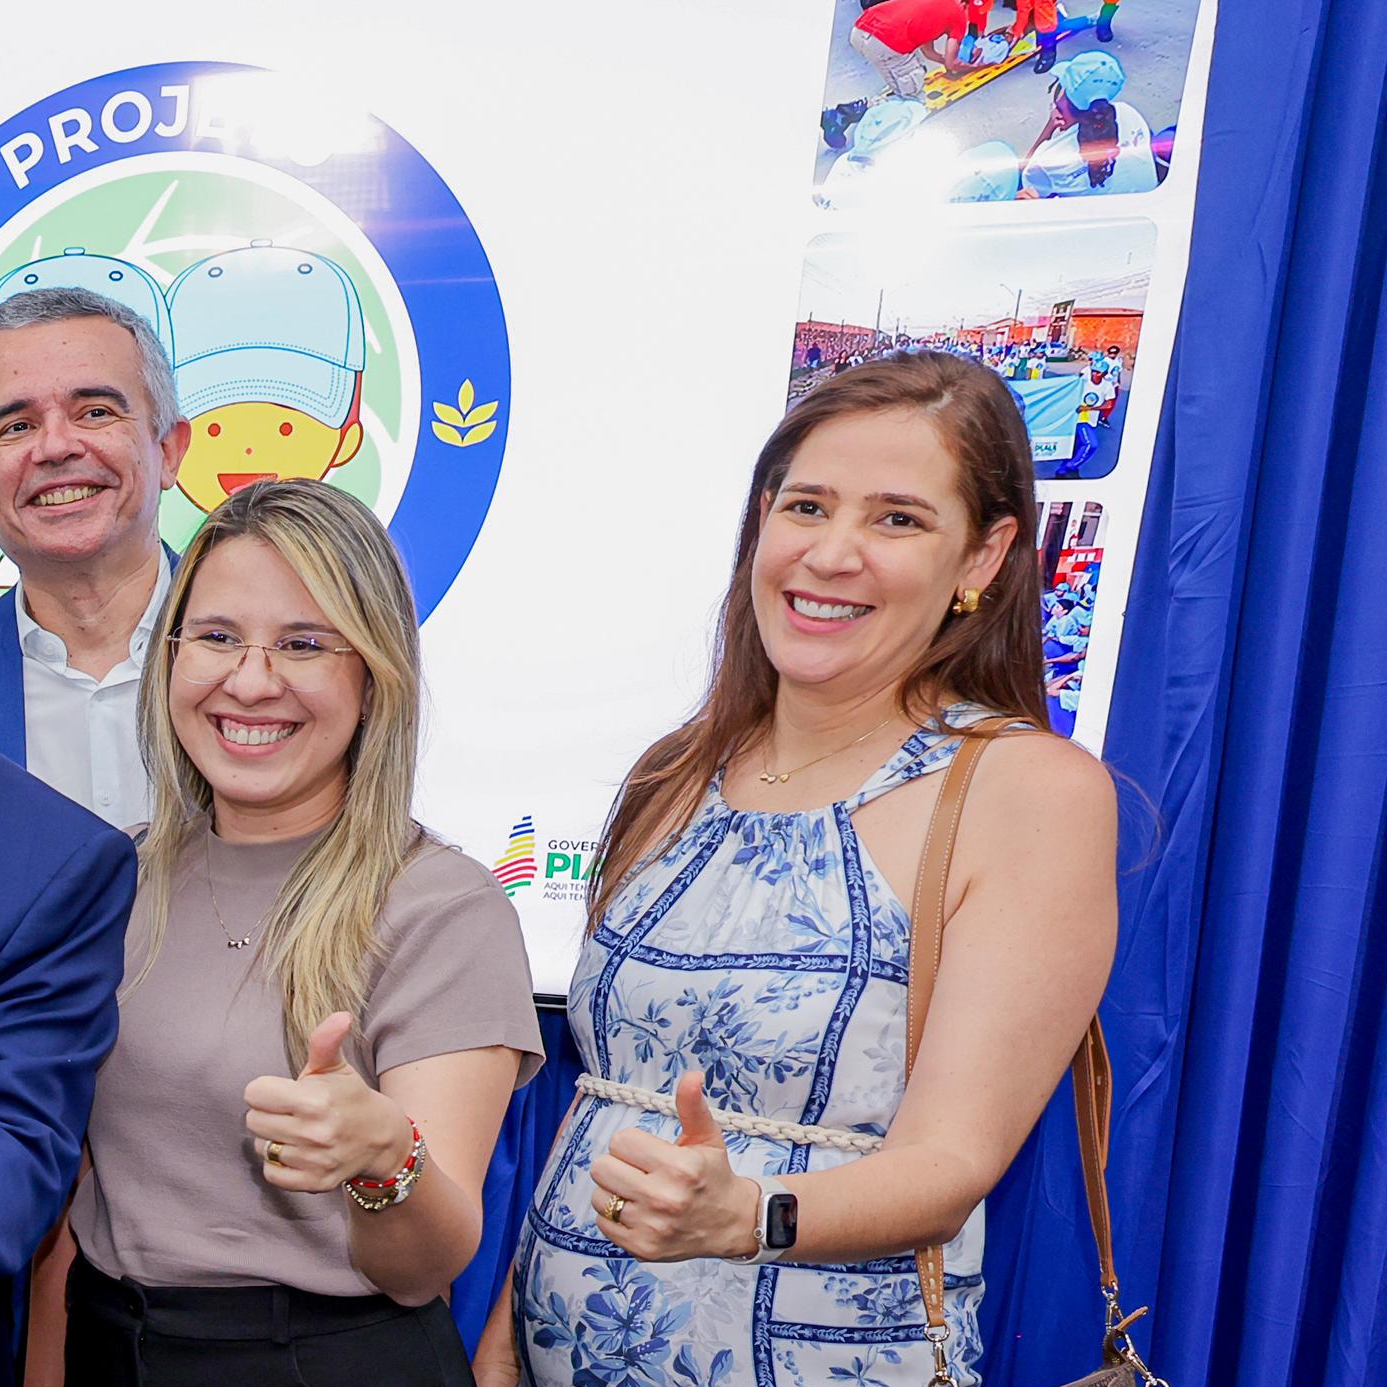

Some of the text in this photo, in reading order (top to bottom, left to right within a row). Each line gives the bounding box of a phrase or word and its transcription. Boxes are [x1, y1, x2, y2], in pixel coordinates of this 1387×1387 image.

[0, 84, 239, 190] PROJE
[548, 840, 600, 851] GOVER
[545, 852, 604, 880] PIA
[544, 882, 568, 891] AQUI
[542, 892, 567, 900] AQUI
